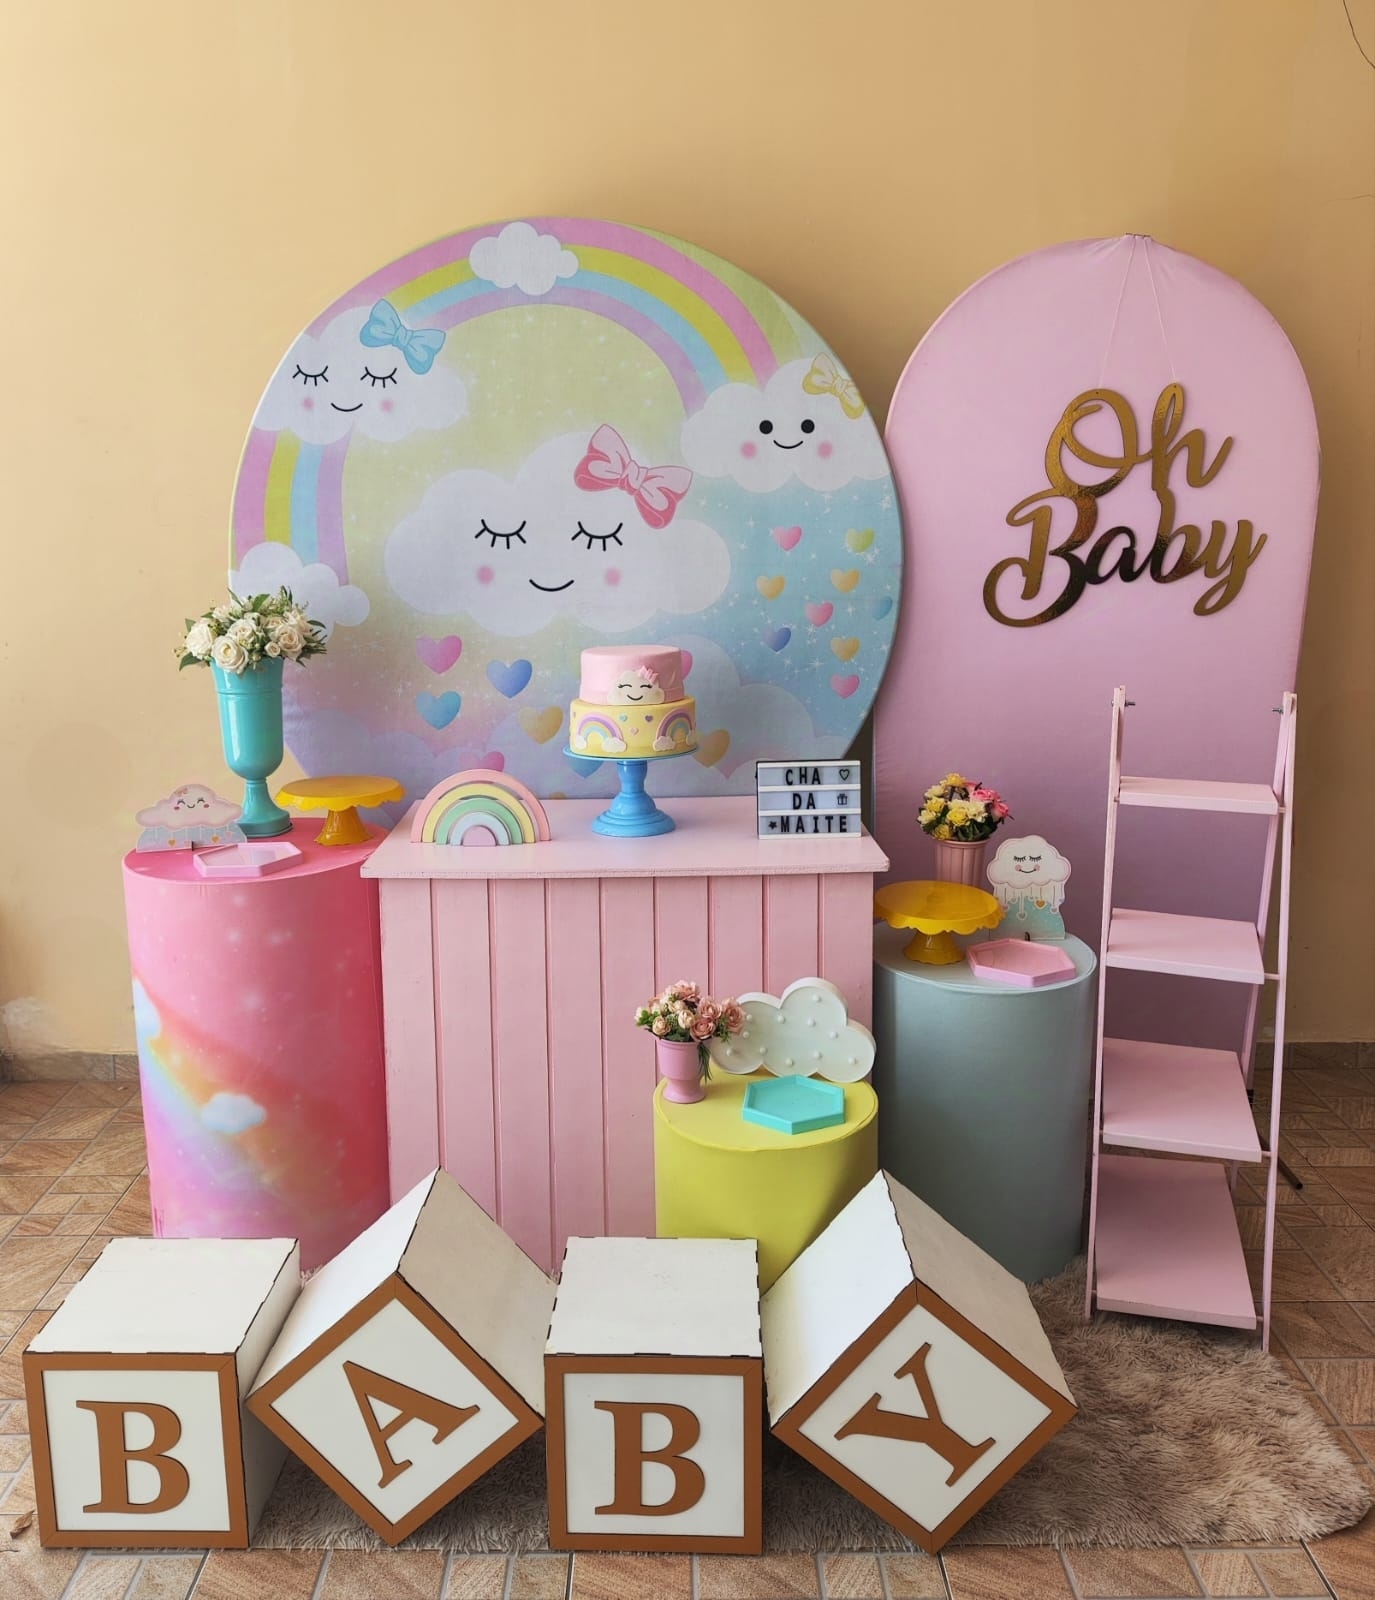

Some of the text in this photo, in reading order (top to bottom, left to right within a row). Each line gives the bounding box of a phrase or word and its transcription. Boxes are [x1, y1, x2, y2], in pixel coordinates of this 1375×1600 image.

[1045, 382, 1234, 499] Oh
[982, 487, 1268, 628] Baby
[785, 766, 821, 786] CHA
[792, 792, 816, 810] DA
[780, 815, 847, 833] MAITE
